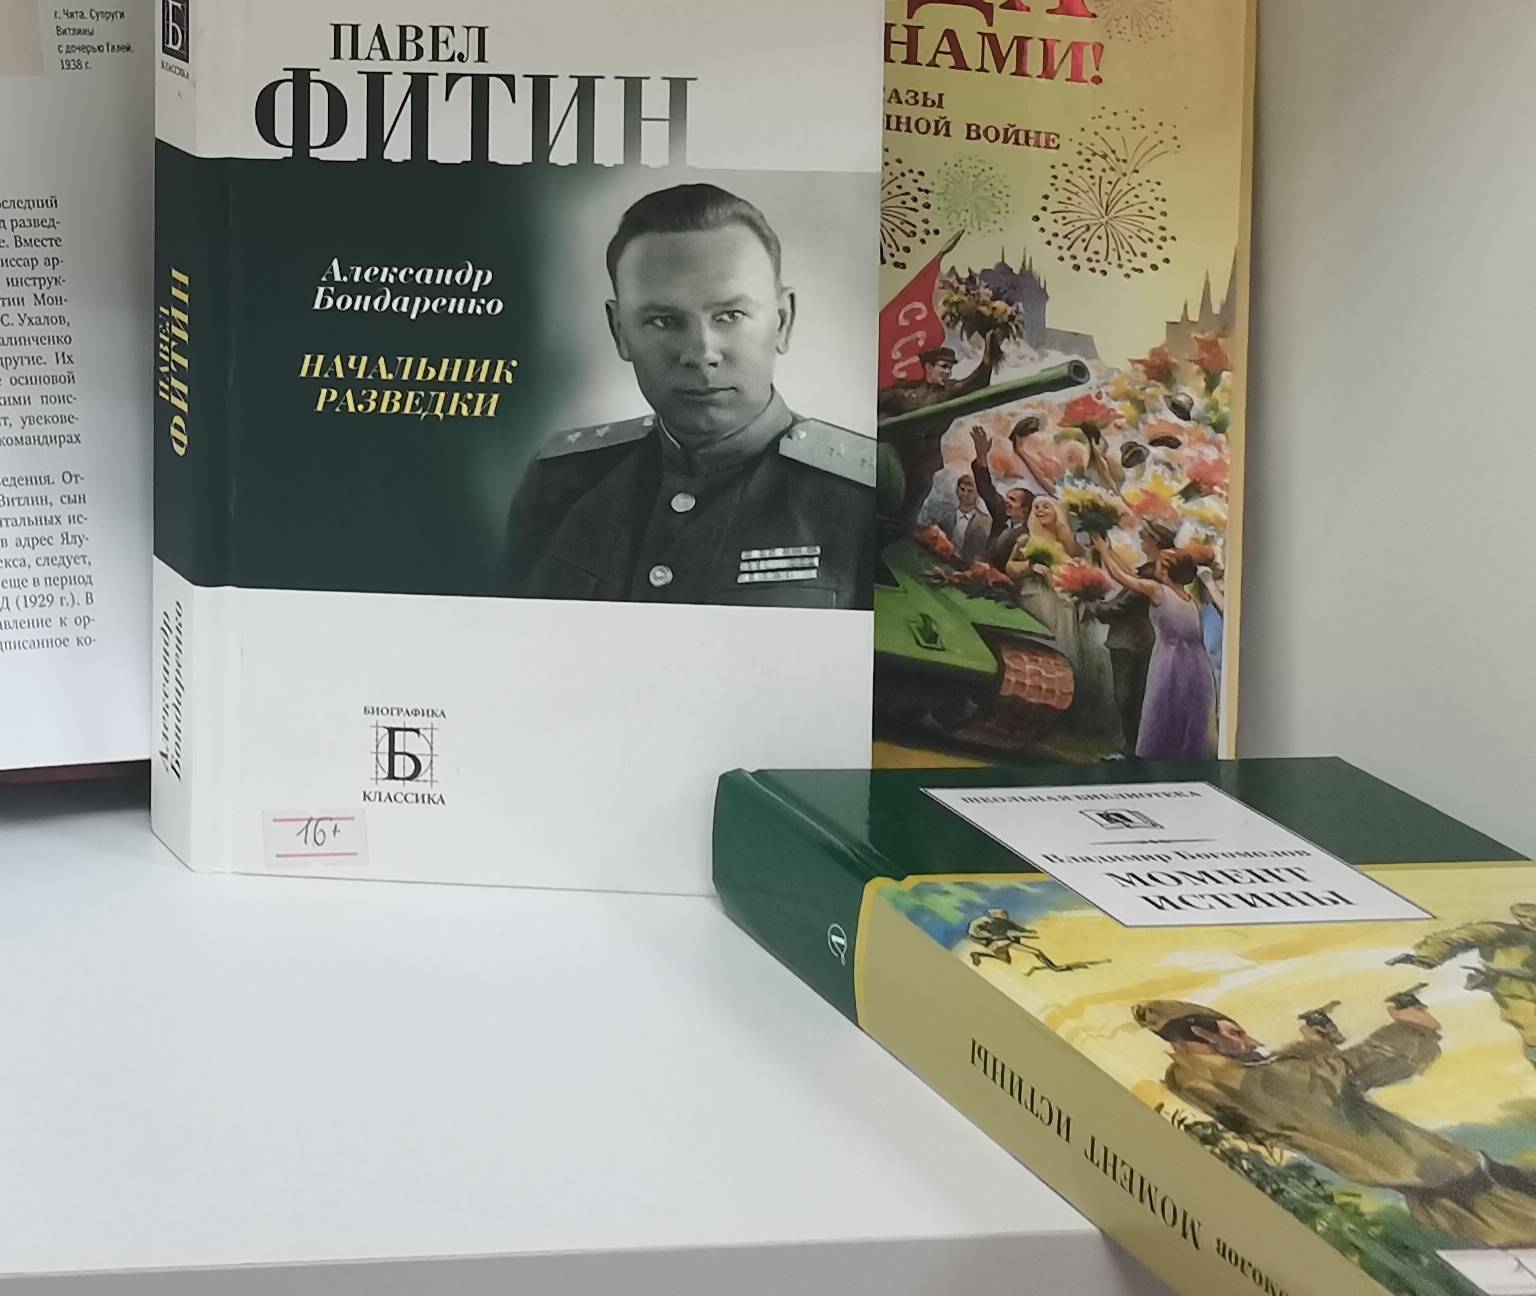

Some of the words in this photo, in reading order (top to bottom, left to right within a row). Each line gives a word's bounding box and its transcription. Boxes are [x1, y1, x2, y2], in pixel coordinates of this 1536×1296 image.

[329, 23, 490, 65] ПАВЕЛ
[884, 22, 1105, 86] НАМИ!
[60, 58, 83, 71] 1938
[883, 87, 945, 109] АЗЫ
[254, 67, 698, 169] ФИТИН
[965, 122, 1061, 150] ВОЙНЕ
[321, 257, 493, 293] Александр
[312, 286, 504, 320] Бондаренко
[159, 305, 170, 402] ПАВЕЛ
[170, 267, 189, 457] ФИТИН
[298, 354, 518, 385] НАЧАЛЬНИК
[313, 388, 501, 422] РАЗВЕДКИ
[363, 705, 447, 720] БИОГРАФИКА
[362, 790, 447, 805] КЛАССИКА
[961, 794, 1073, 805] ШКОЛЬНАЯ
[1076, 789, 1203, 803] БИБЛИОТЕКА
[296, 816, 341, 847] 16+
[1042, 849, 1172, 865] Владимир
[1175, 848, 1312, 859] Богомолов
[1105, 865, 1315, 889] МОМЕНТ
[1142, 889, 1355, 912] ИСТИНЫ
[969, 1038, 1073, 1144] ИСТИНЫ
[1084, 1134, 1202, 1251] МОМЕНТ
